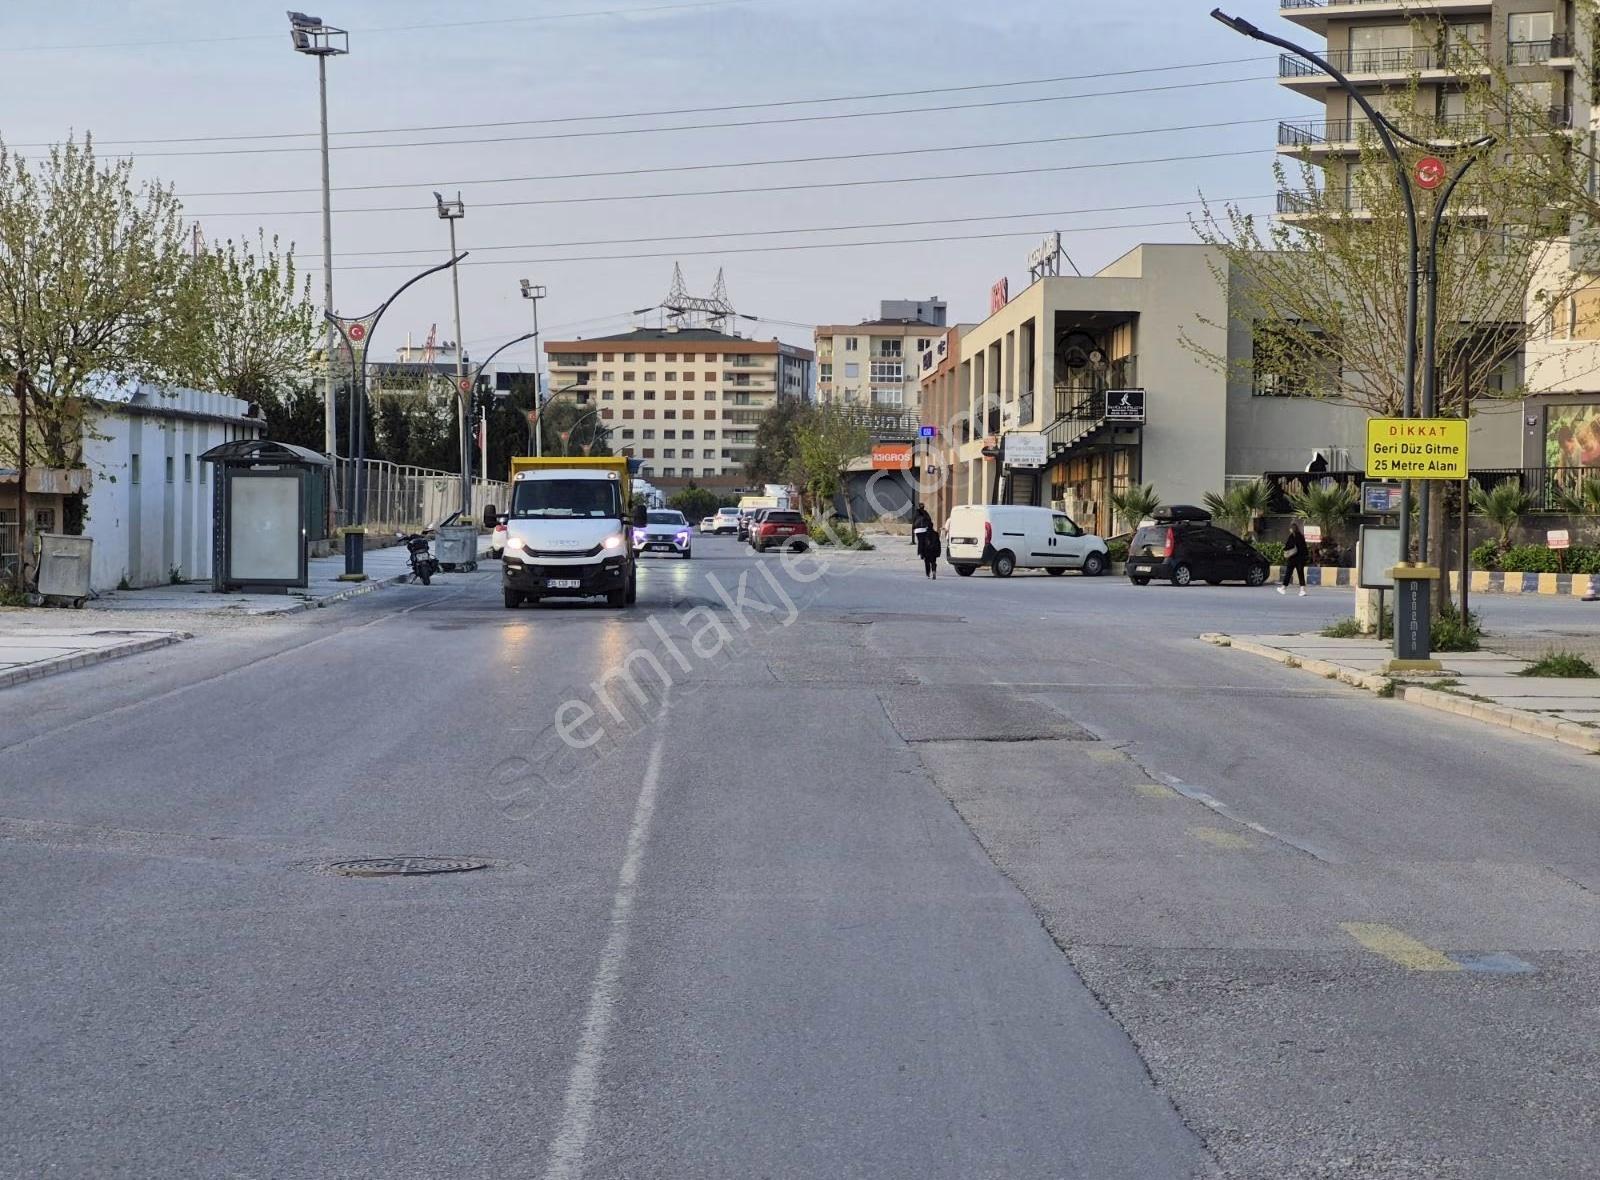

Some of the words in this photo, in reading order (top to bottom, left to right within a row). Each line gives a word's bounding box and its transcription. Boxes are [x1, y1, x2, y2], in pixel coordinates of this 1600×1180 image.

[1389, 424, 1447, 436] DİKKAT
[1374, 443, 1398, 454] Geri
[1401, 443, 1422, 454] Düz
[1425, 443, 1459, 454] Gitme
[1374, 460, 1388, 470] 25
[1391, 460, 1425, 471] Metre
[1428, 460, 1457, 471] Alanı
